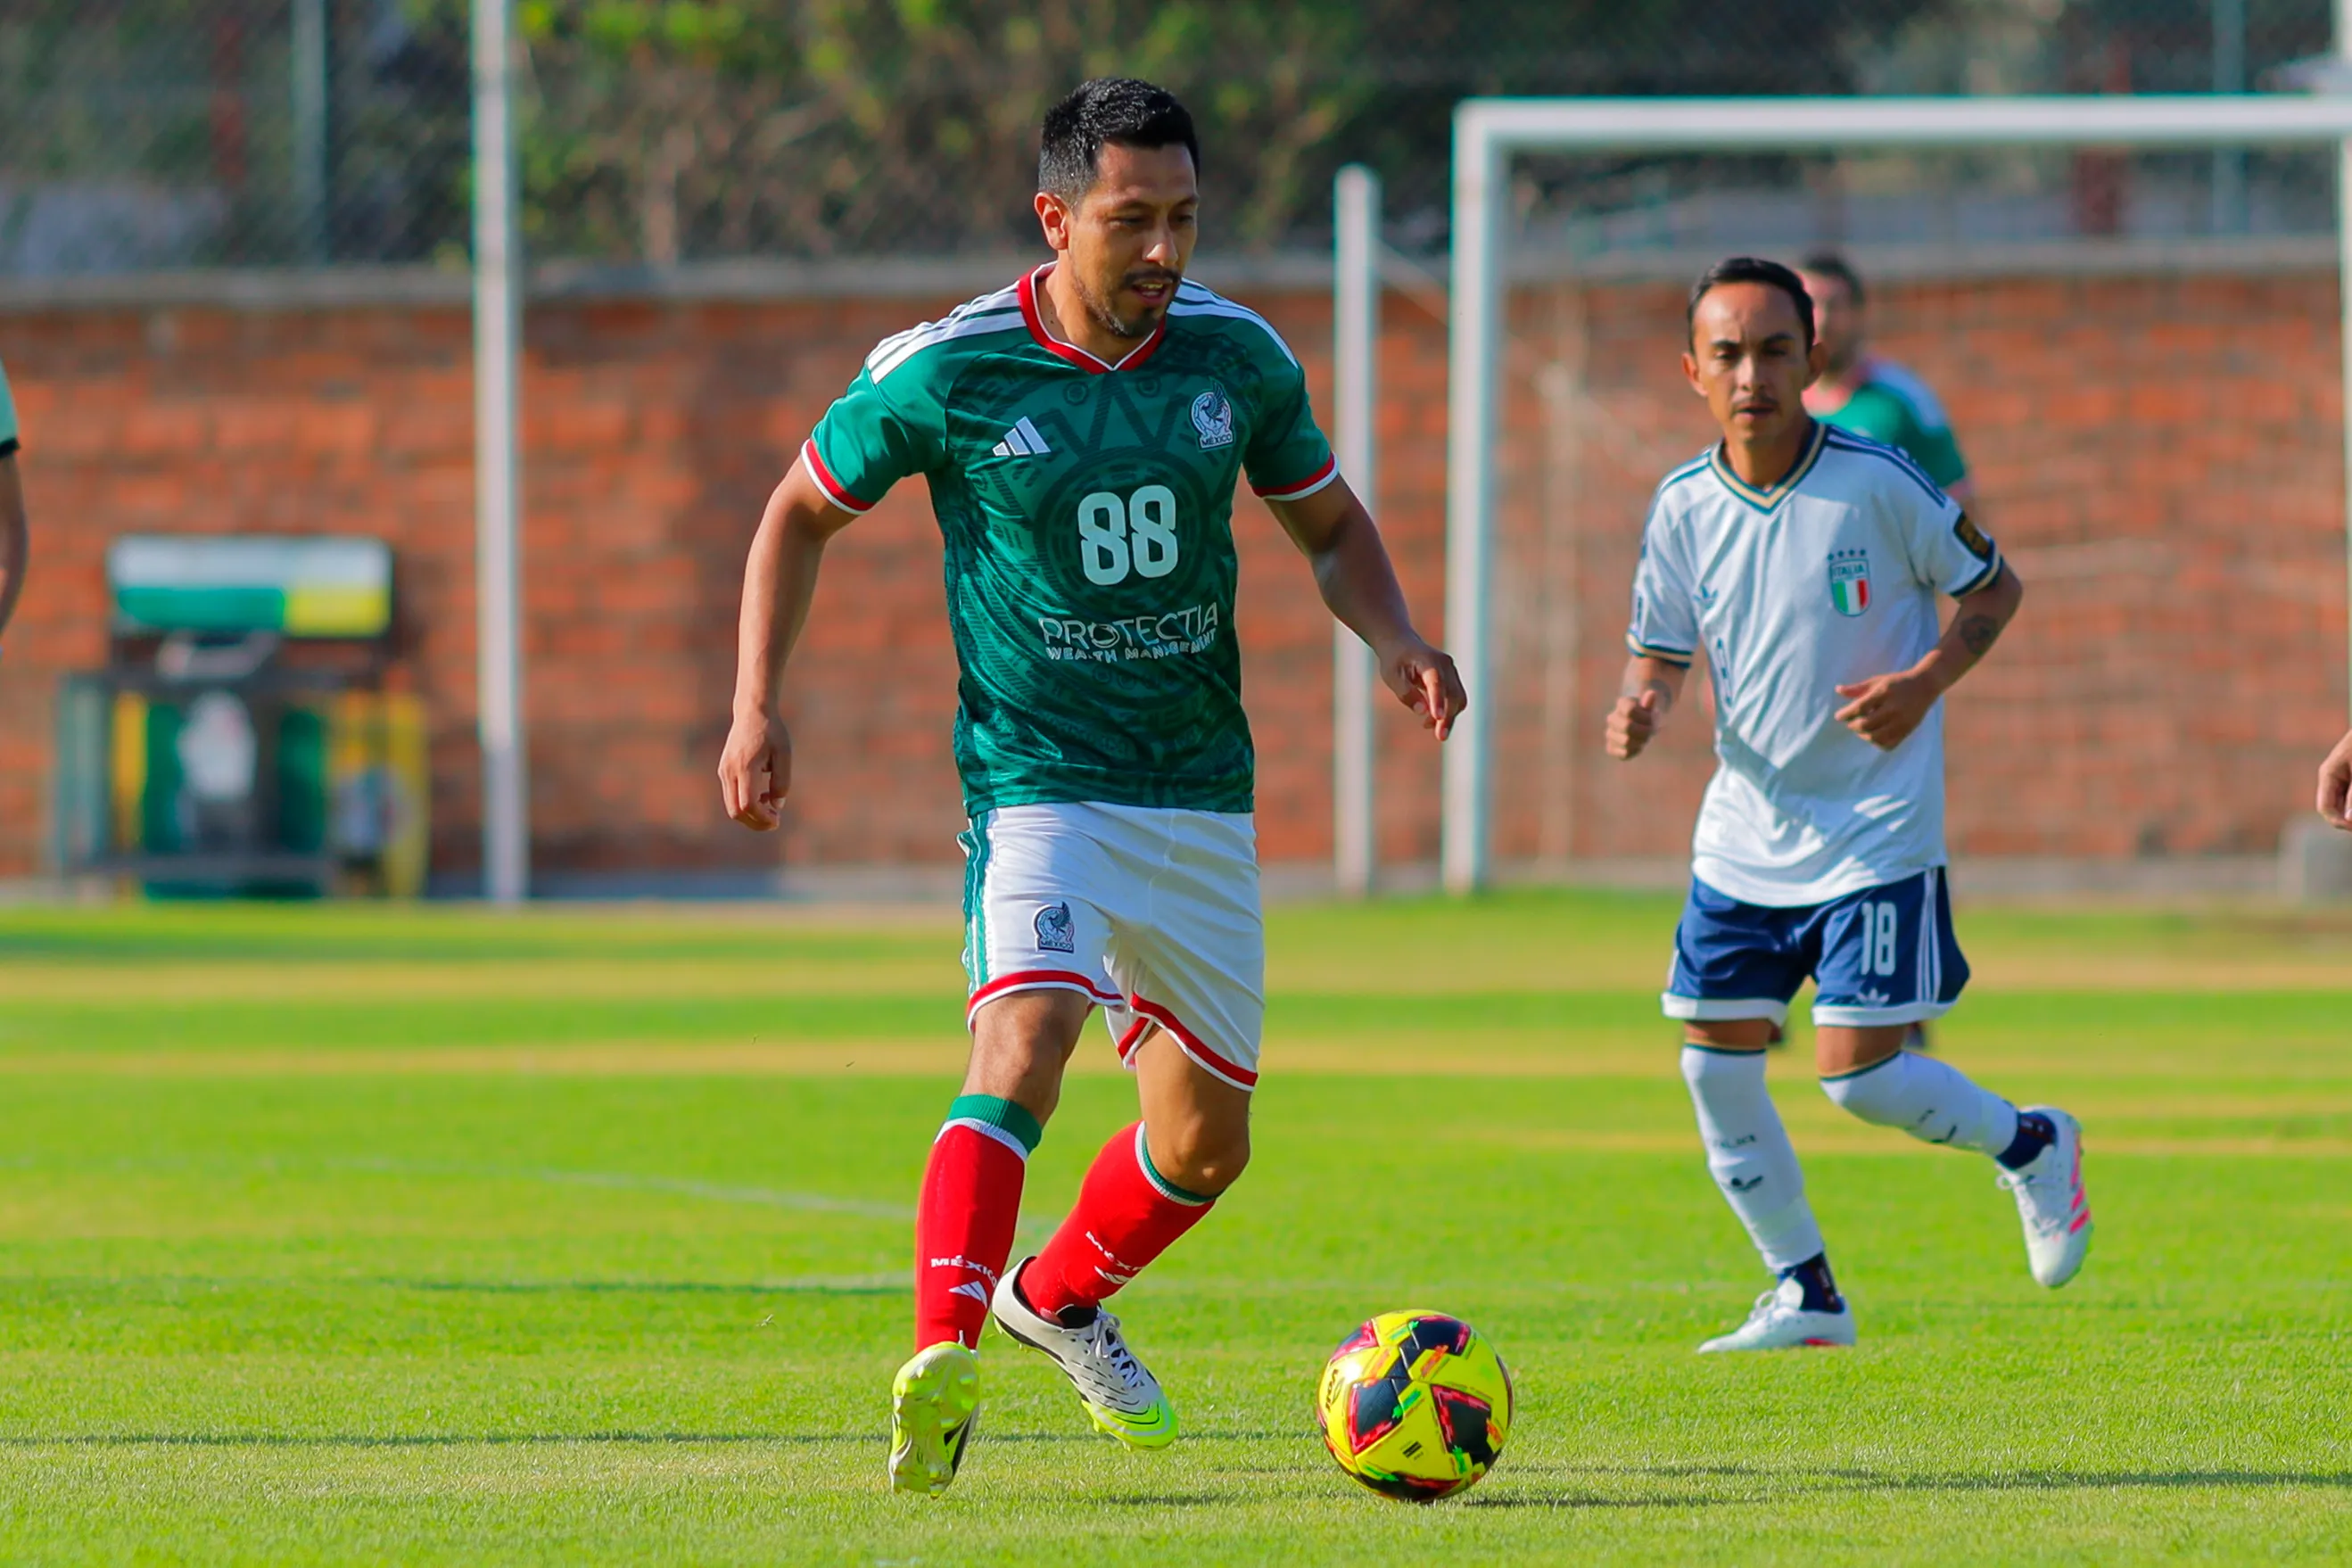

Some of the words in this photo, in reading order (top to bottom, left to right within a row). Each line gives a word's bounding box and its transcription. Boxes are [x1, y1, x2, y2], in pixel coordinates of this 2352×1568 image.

[1077, 484, 1177, 585] 88
[1038, 602, 1218, 648] PROTECTIA
[1861, 901, 1897, 976] 18
